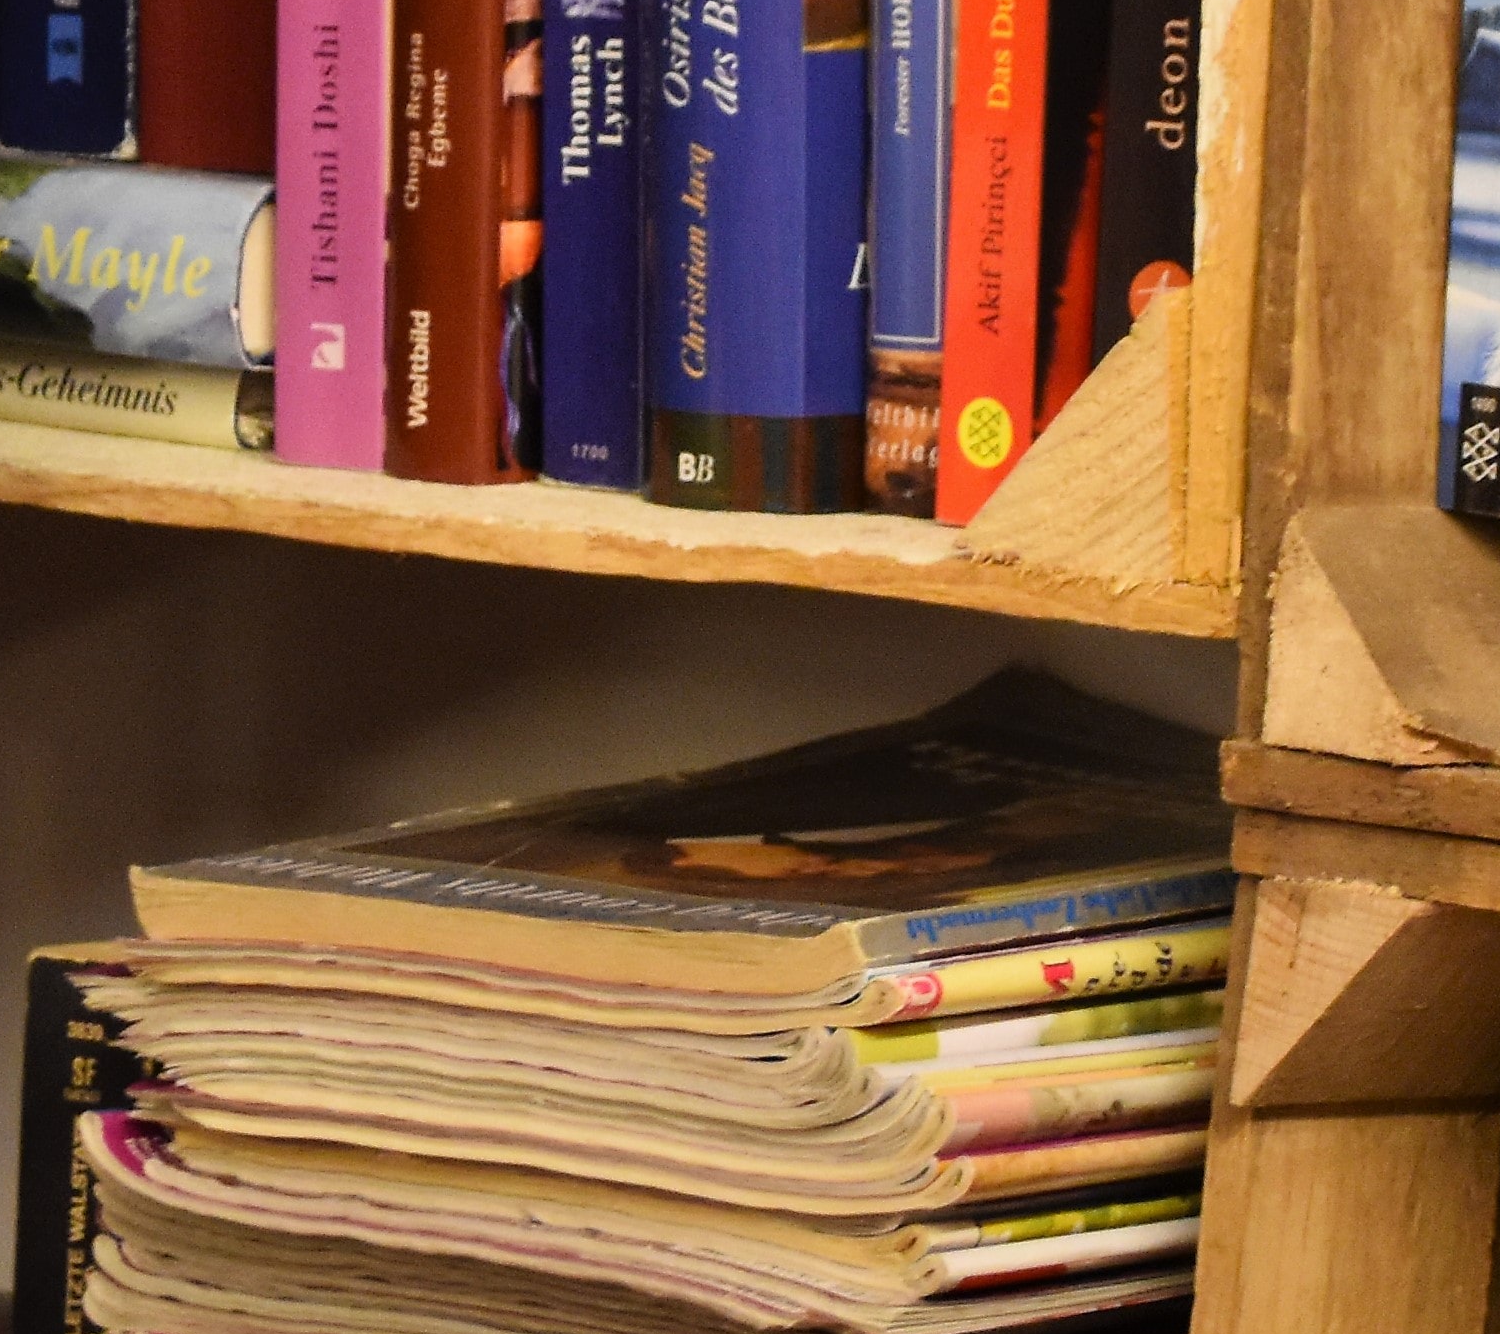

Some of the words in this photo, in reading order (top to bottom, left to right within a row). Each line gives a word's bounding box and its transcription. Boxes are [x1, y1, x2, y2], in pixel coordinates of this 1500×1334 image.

[312, 24, 339, 133] Doshi
[561, 34, 591, 185] Thomas
[598, 38, 632, 147] Lynch
[701, 47, 739, 116] des
[1146, 18, 1188, 150] deon
[26, 222, 212, 312] Mayle
[310, 148, 339, 288] Tishani
[407, 309, 430, 430] Weltbild
